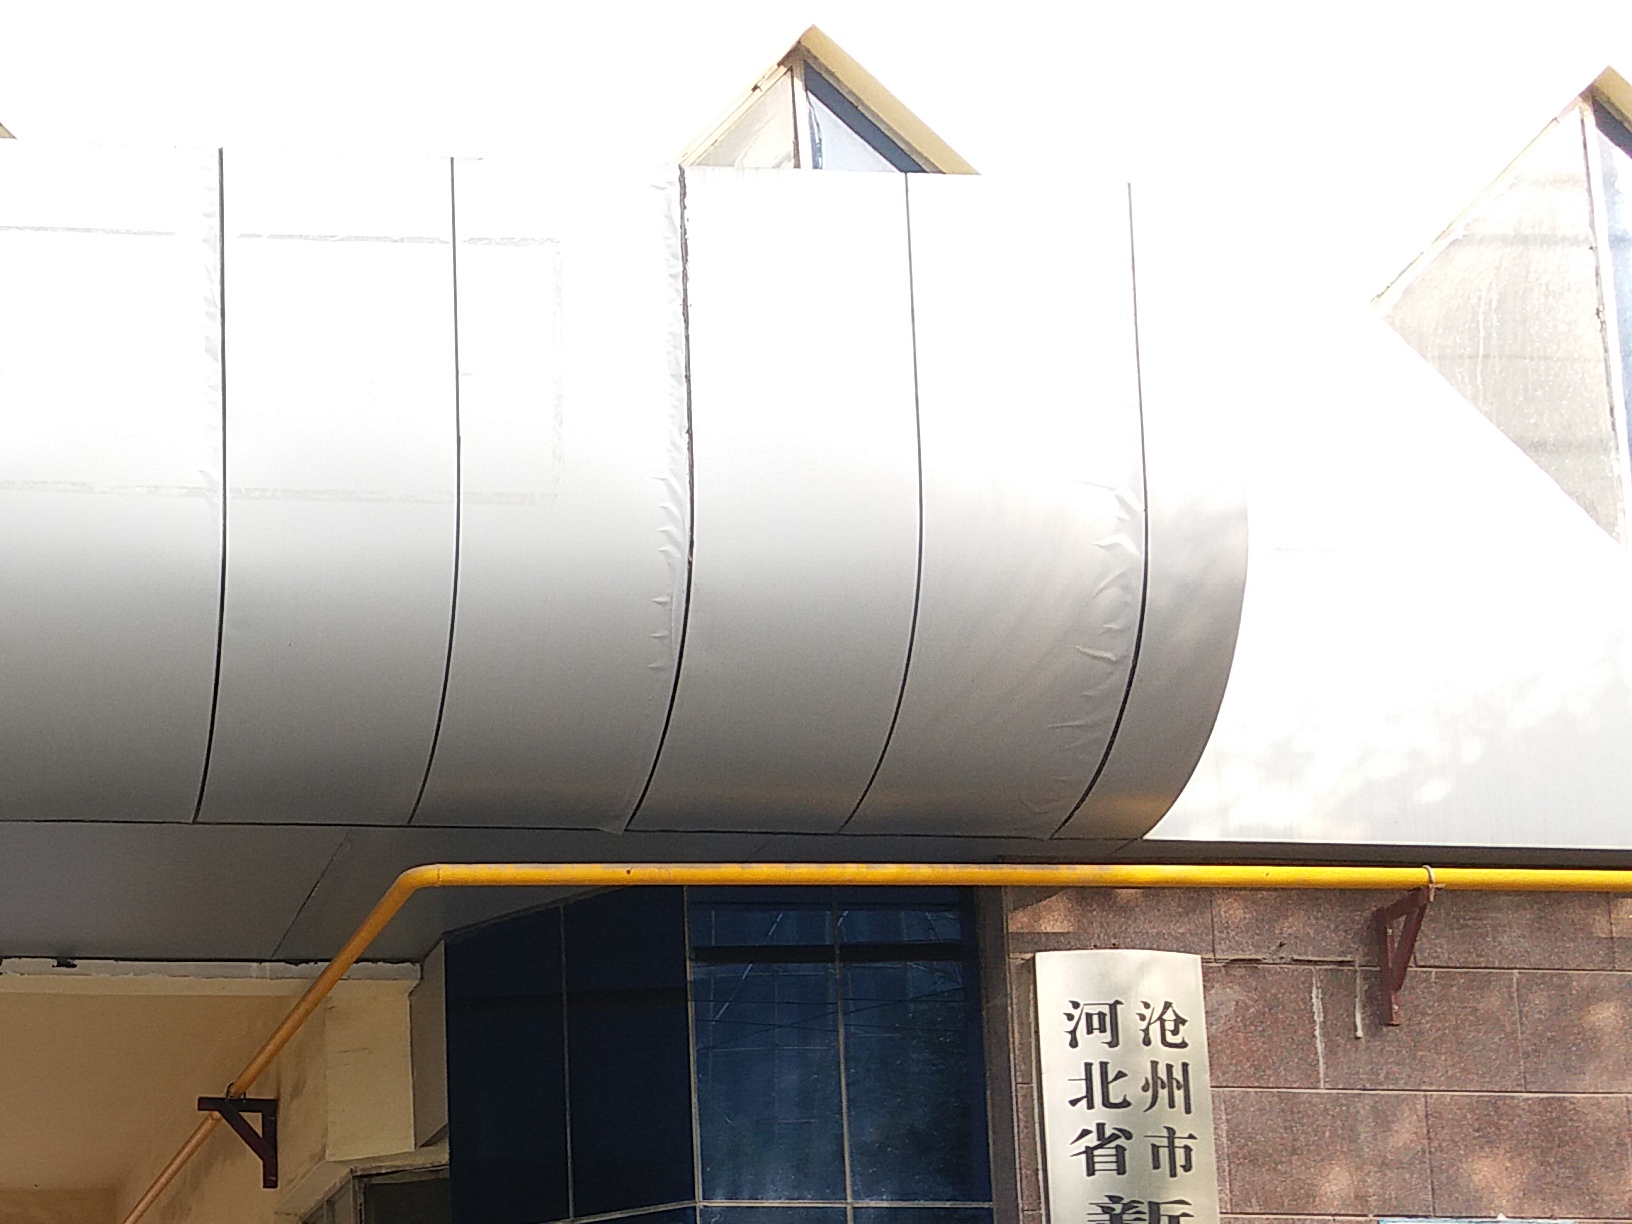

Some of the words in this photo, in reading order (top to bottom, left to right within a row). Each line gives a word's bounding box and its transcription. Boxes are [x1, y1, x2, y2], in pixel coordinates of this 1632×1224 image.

[1064, 998, 1134, 1179] 河北省
[1139, 998, 1198, 1179] 沧州市
